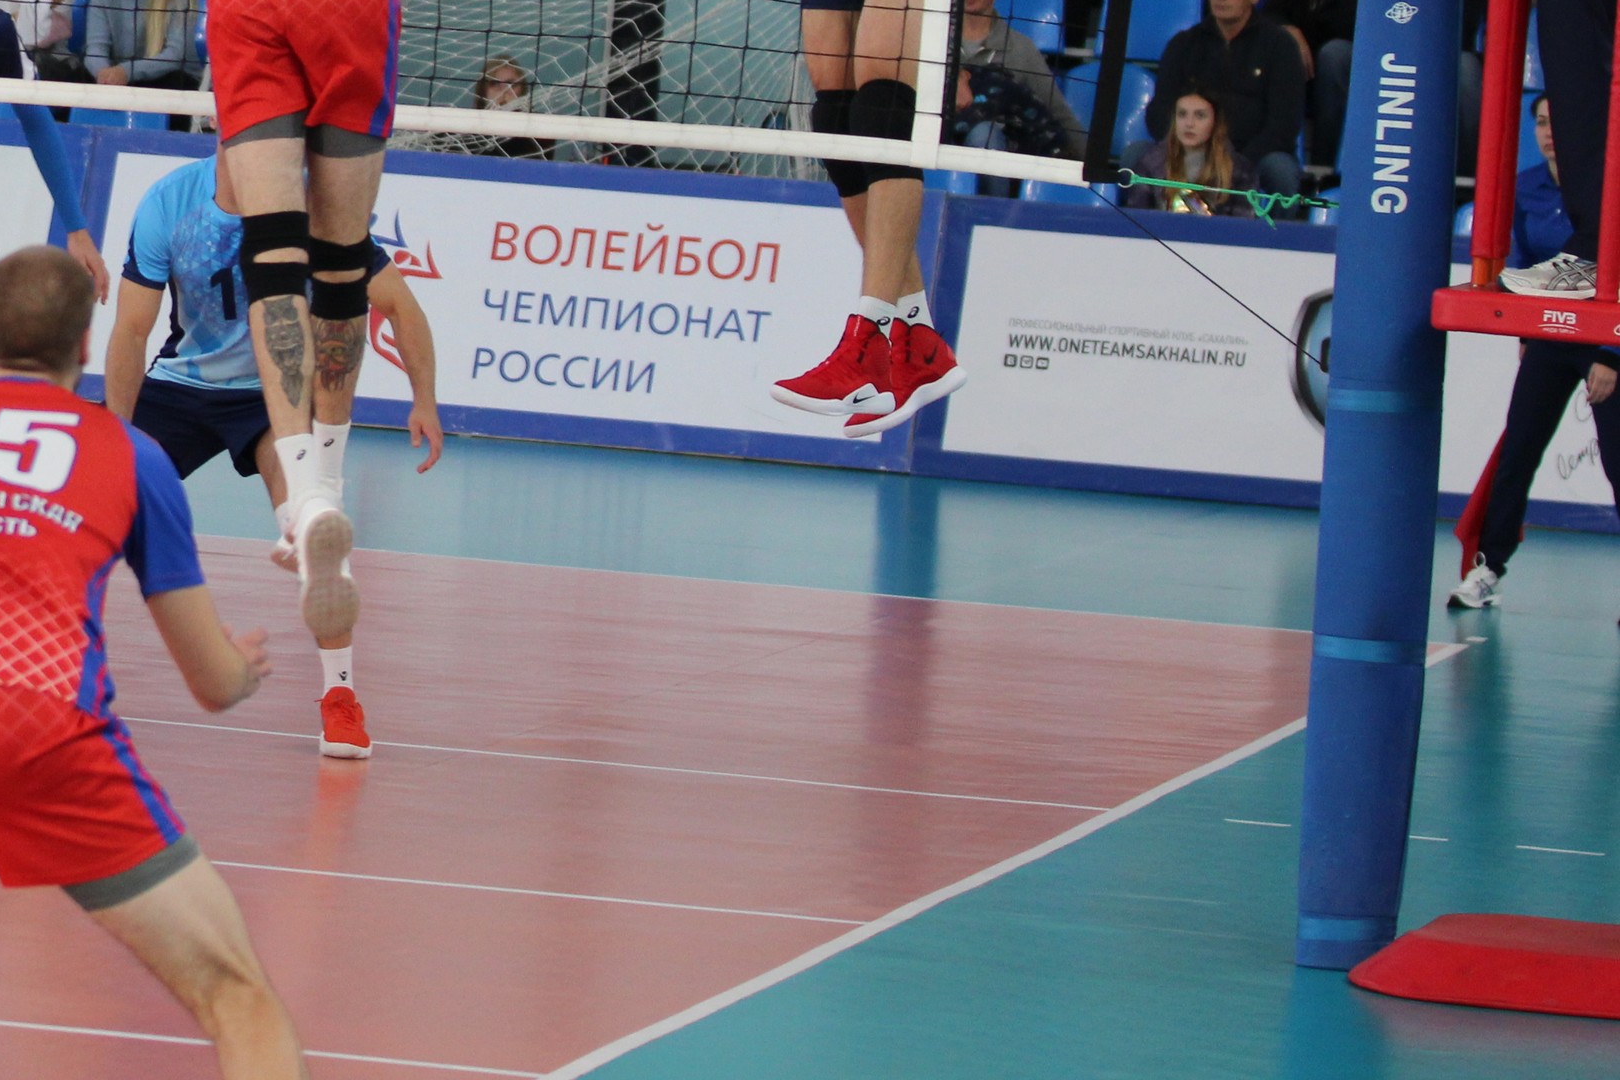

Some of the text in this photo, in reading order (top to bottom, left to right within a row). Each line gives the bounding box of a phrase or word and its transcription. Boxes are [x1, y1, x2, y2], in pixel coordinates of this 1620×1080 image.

[1370, 53, 1417, 214] JINLING
[490, 221, 781, 283] ВОЛЕЙБОЛ
[483, 288, 772, 343] ЧЕМПИОНАТ
[1543, 309, 1577, 325] FIVB
[472, 347, 656, 394] РОССИИ
[1008, 333, 1247, 368] WWW.ONETEAMSAKHALIN.RU
